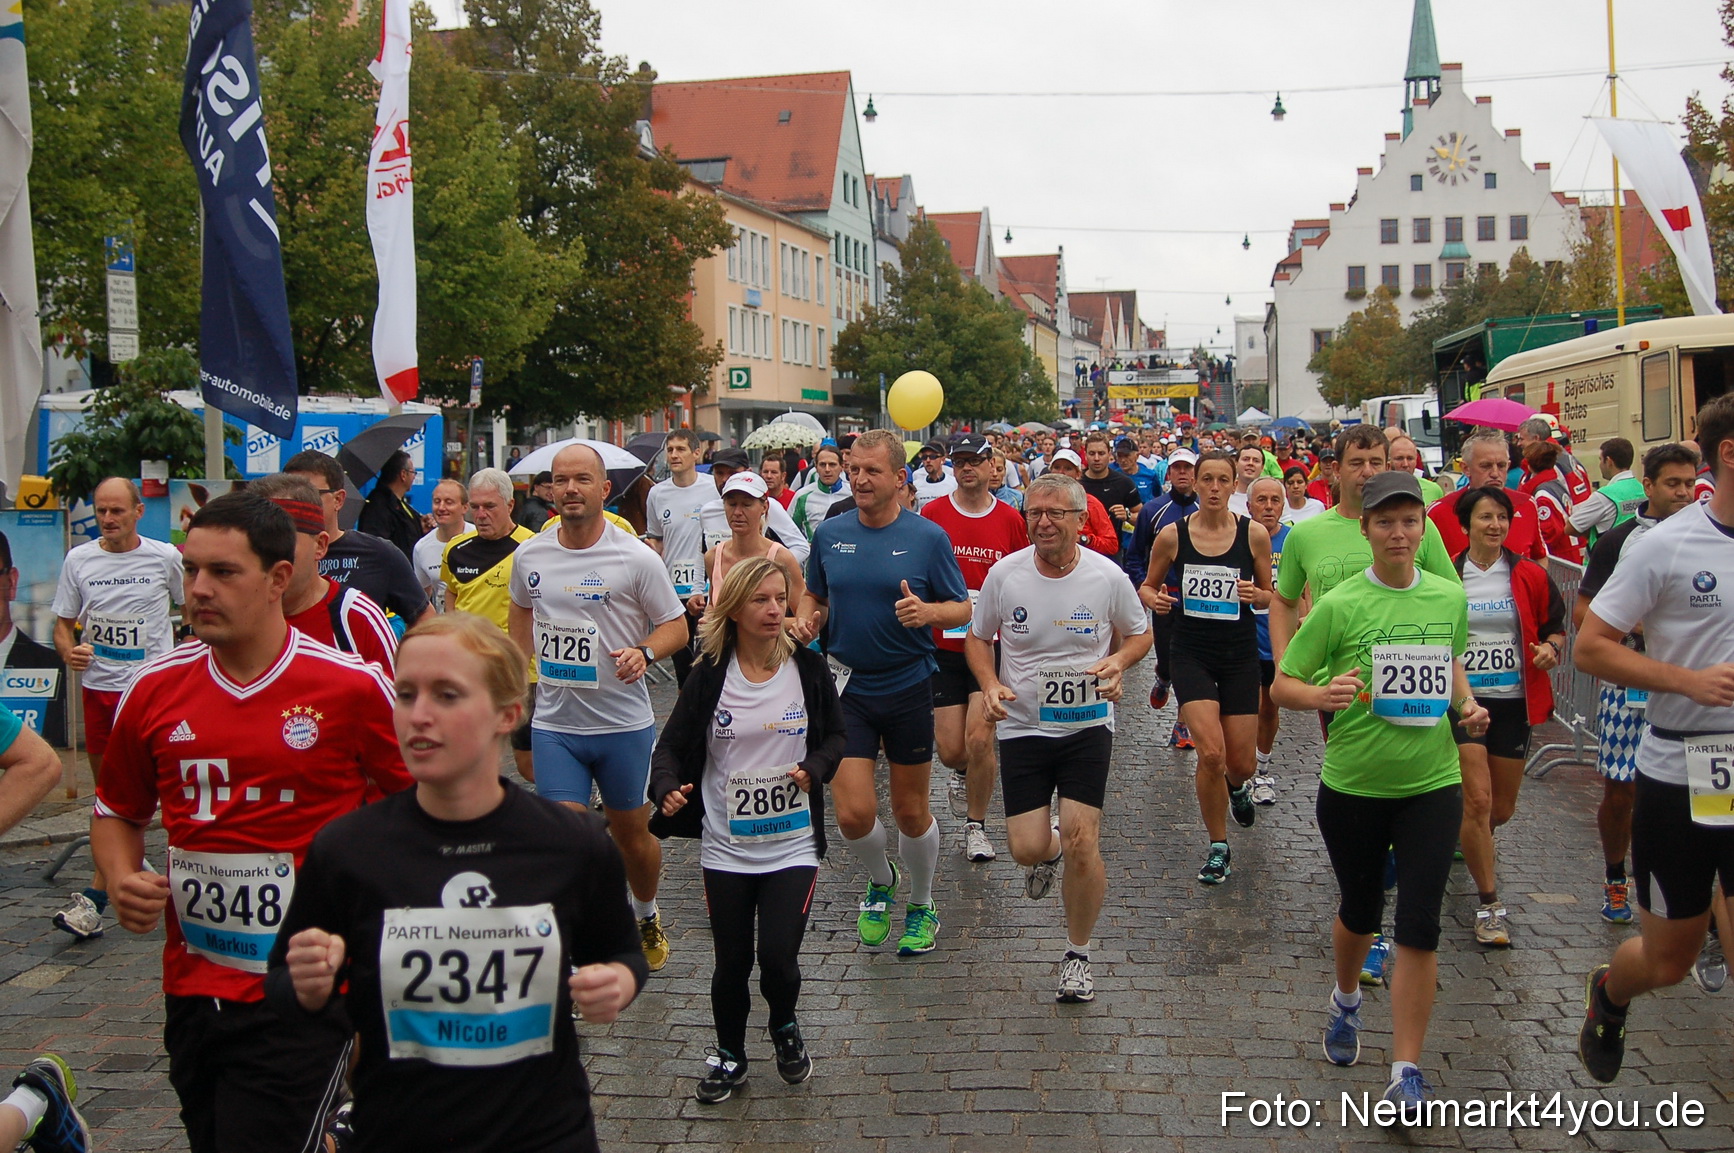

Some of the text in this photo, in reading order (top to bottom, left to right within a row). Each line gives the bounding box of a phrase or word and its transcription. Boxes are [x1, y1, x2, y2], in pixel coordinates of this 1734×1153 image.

[732, 370, 747, 386] D
[1564, 371, 1615, 400] Bayerisches
[1137, 388, 1168, 396] START
[1564, 402, 1588, 420] Rotes
[89, 576, 151, 587] www.hasit.de
[1204, 570, 1232, 578] Neumarkt
[1188, 577, 1236, 599] 2837
[1690, 594, 1722, 602] PARTL
[1200, 602, 1220, 612] Petra
[537, 620, 585, 634] PARTL Neumarkt
[92, 624, 138, 647] 2451
[541, 632, 591, 662] 2126
[1374, 652, 1441, 661] PARTL Neumarkt
[1463, 647, 1516, 671] 2268
[549, 665, 577, 679] Gerald
[1381, 664, 1447, 695] 2385
[6, 677, 36, 689] CSU
[1481, 676, 1500, 686] Inge
[1045, 675, 1102, 704] 2611
[1053, 709, 1097, 721] Wolfgang
[1402, 702, 1431, 714] Anita
[168, 733, 196, 743] adidas
[715, 728, 736, 736] PARTL
[1687, 744, 1722, 754] PARTL
[735, 781, 802, 816] 2862
[750, 818, 791, 834] Justyna
[455, 844, 493, 855] MASITA
[172, 859, 270, 878] PARTL Neumarkt
[182, 878, 282, 927] 2348
[387, 925, 531, 940] PARTL Neumarkt
[205, 932, 258, 956] Markus
[401, 946, 544, 1005] 2347
[437, 1019, 508, 1043] Nicole
